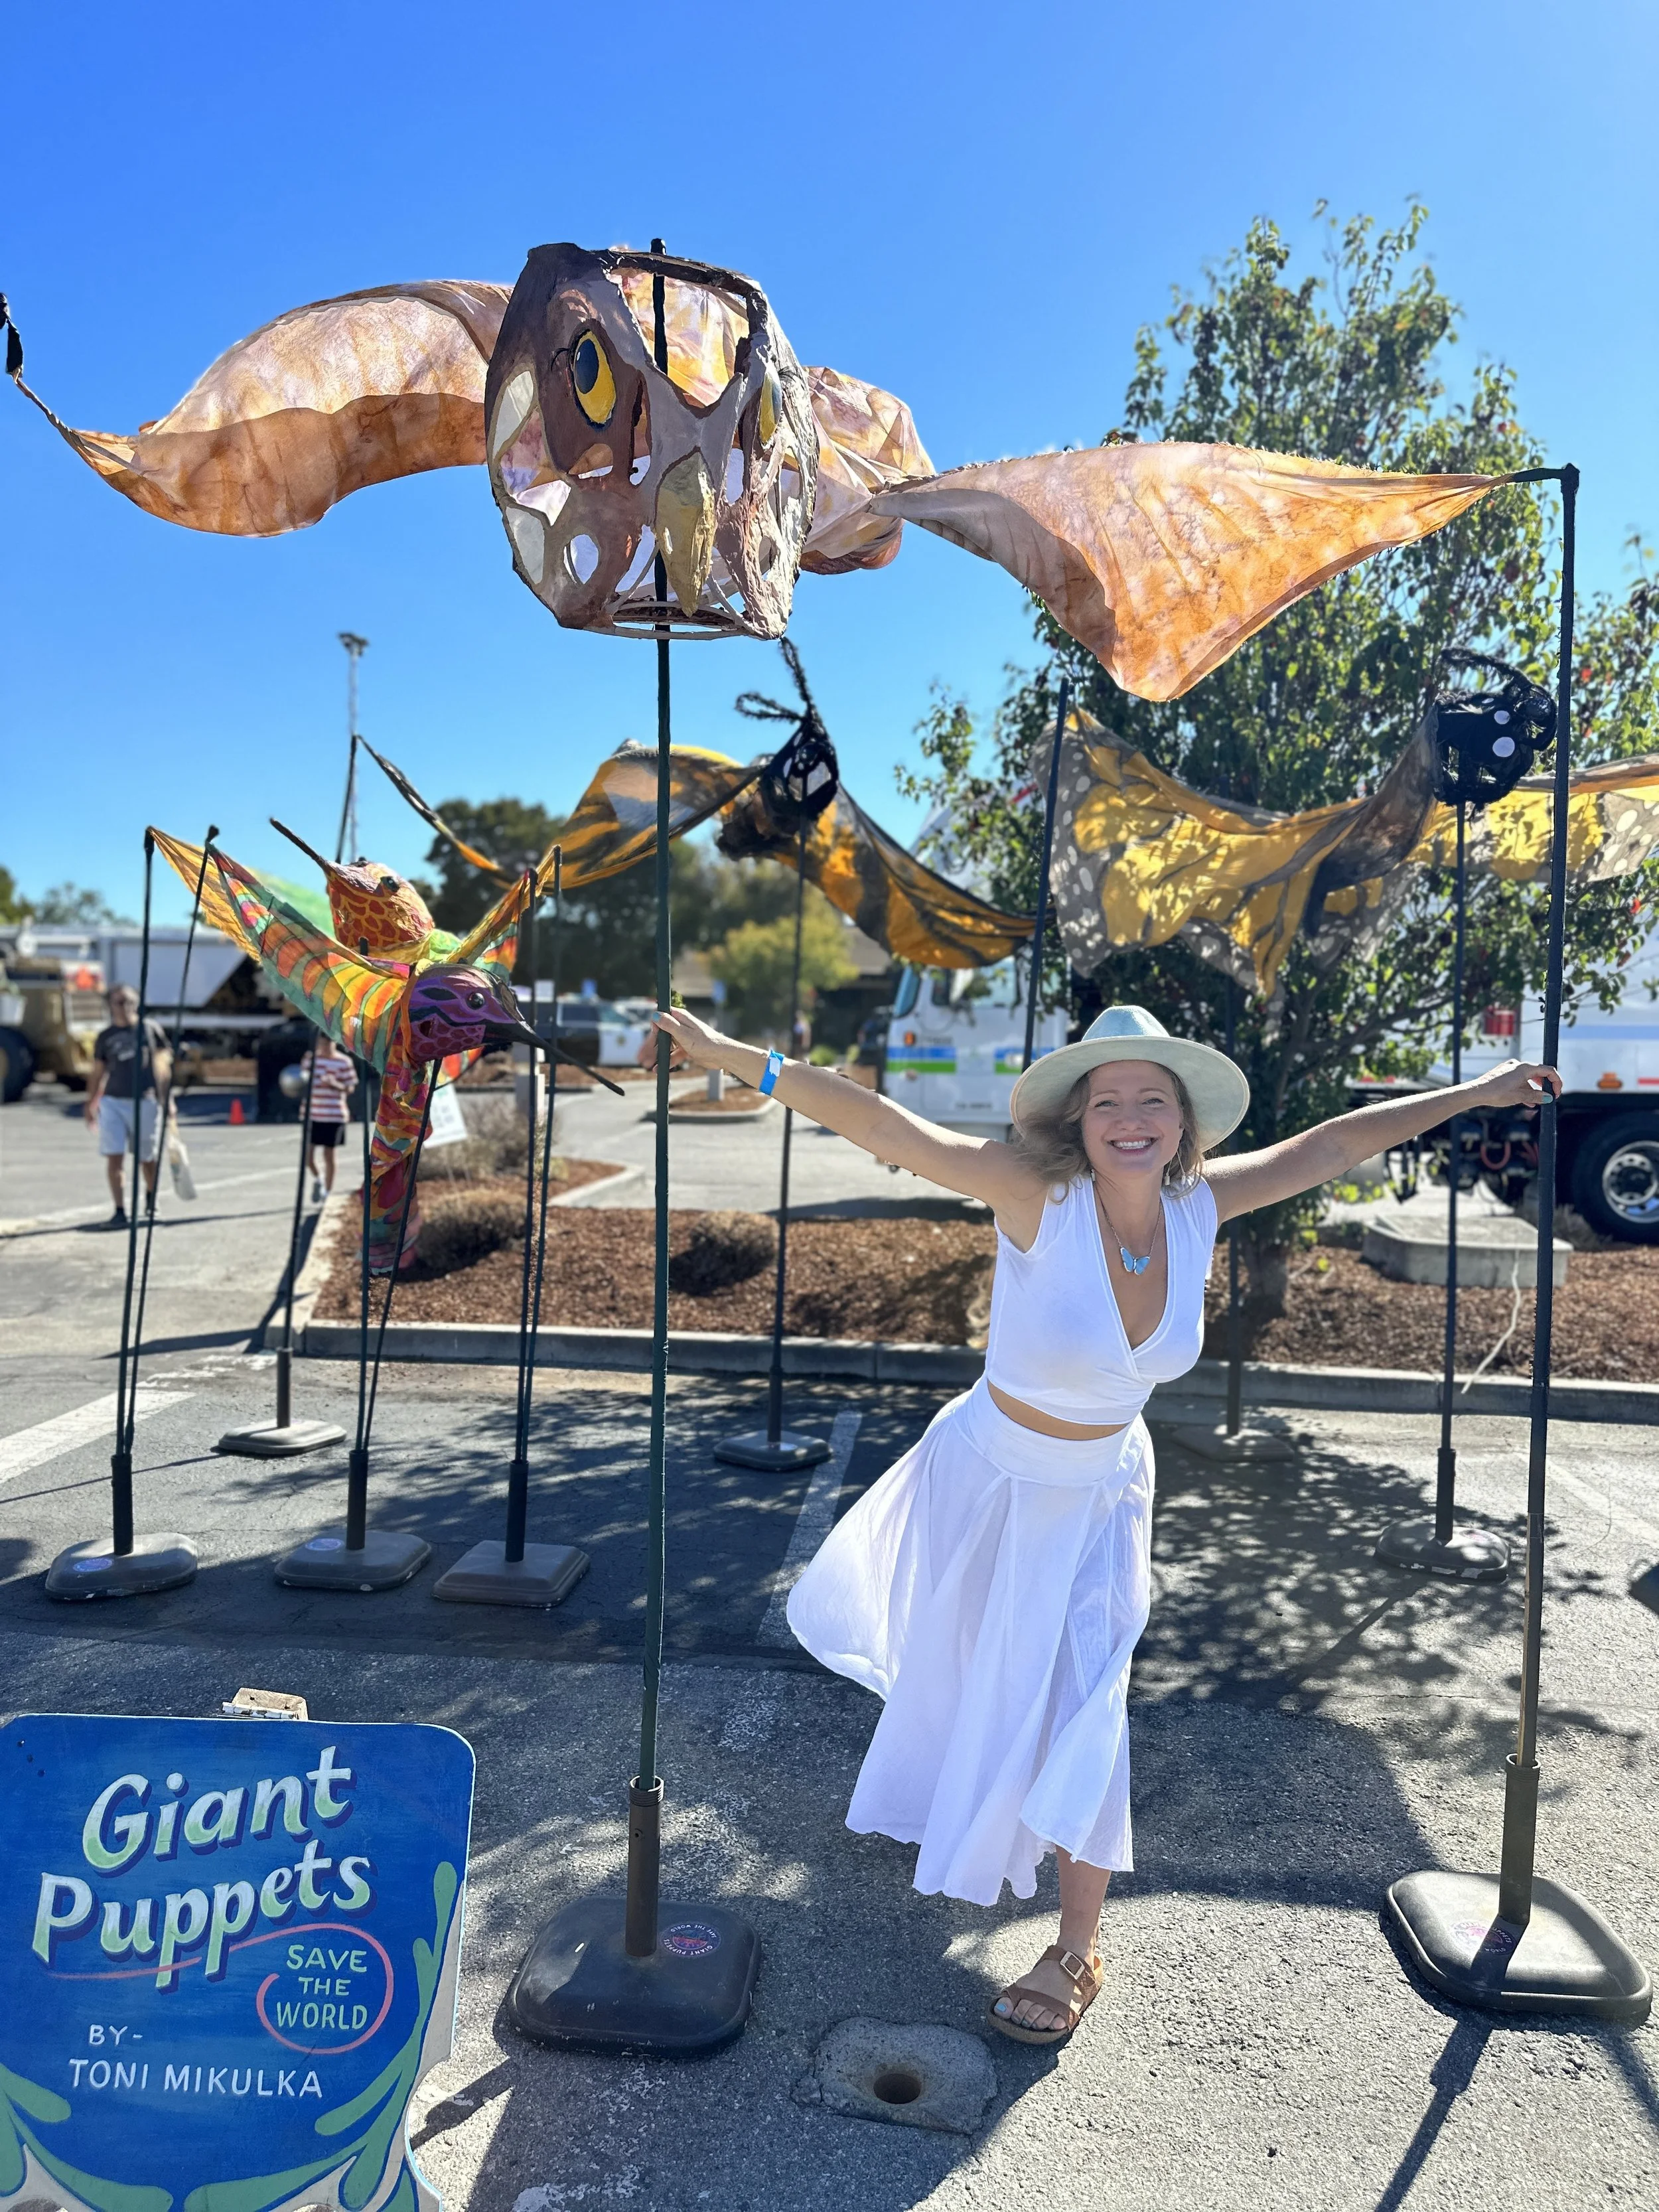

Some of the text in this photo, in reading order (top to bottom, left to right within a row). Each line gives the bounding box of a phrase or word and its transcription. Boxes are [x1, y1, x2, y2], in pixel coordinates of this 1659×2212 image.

[81, 1745, 352, 1872] Giant
[32, 1840, 372, 1988] Puppets
[670, 1924, 691, 1933] WORLD
[287, 1944, 368, 1973] SAVE
[663, 1939, 713, 1955] GIANT PUPPETS
[299, 1976, 350, 1996] THE
[276, 2001, 368, 2030] WORLD
[88, 2024, 143, 2045] BY-
[68, 2058, 324, 2098] TONI MIKULKA
